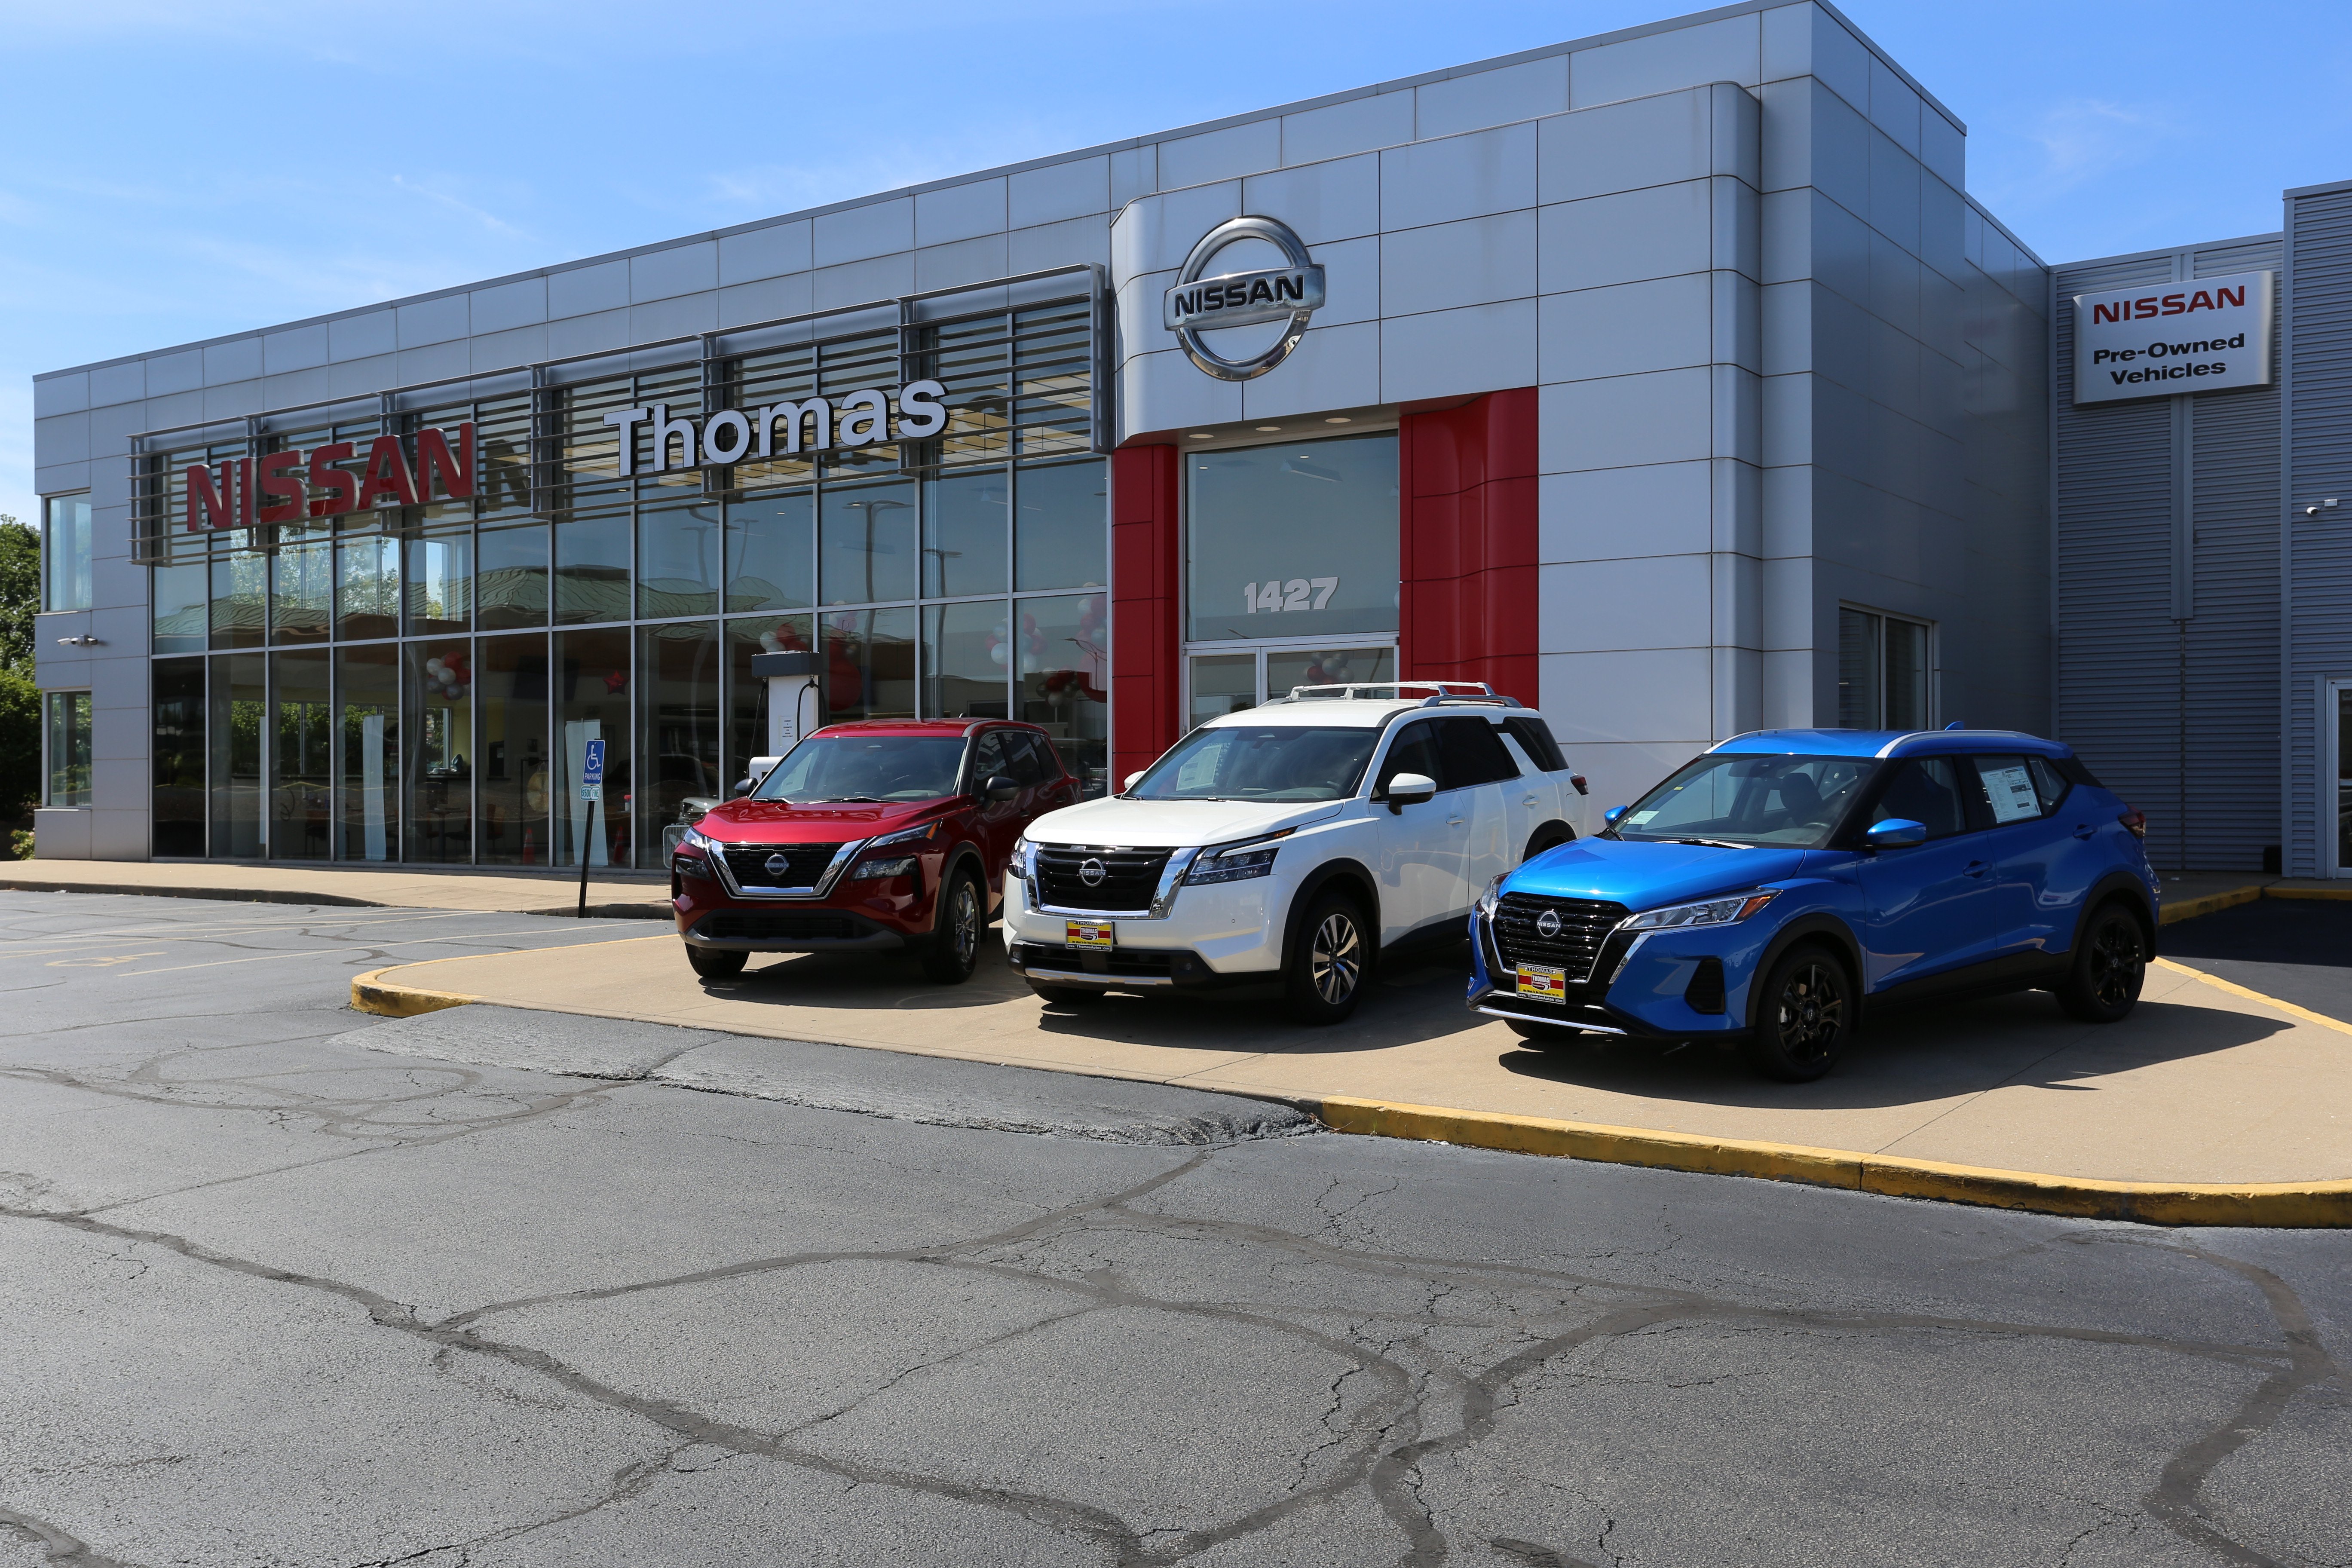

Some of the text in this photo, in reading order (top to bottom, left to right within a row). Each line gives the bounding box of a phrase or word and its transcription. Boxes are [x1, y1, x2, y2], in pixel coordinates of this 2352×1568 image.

[1175, 275, 1305, 318] NISSAN
[2094, 285, 2245, 325] NISSAN
[2094, 334, 2245, 364] Pre-Owned
[2110, 362, 2226, 385] Vehicles
[603, 379, 949, 477] Thomas
[187, 422, 477, 532] NISSAN
[1244, 577, 1339, 613] 1427
[582, 789, 591, 797] $500
[1532, 975, 1550, 983] THOMAS
